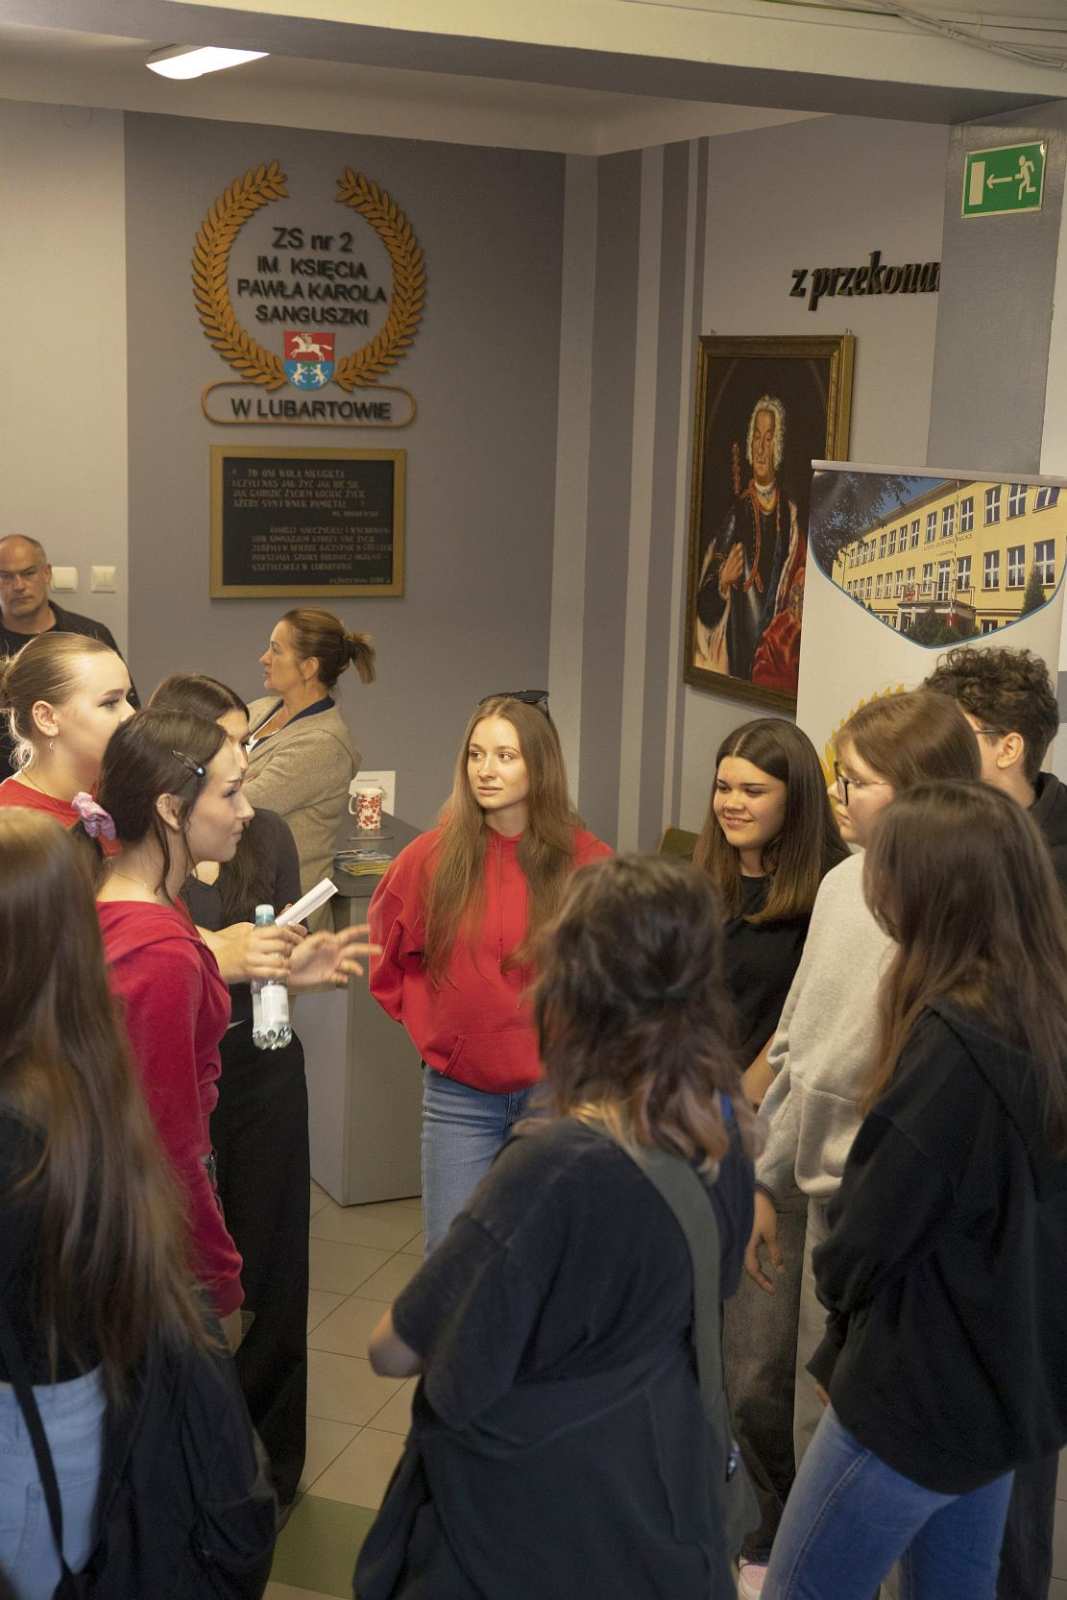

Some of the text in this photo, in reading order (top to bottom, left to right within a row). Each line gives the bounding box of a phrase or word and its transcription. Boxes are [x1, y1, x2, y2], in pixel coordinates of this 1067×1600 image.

[272, 226, 354, 253] ZS nr 2
[290, 257, 369, 282] KSIĘCIA
[789, 250, 941, 312] z przekona
[237, 278, 387, 303] PAWŁA KAROLA
[255, 304, 369, 327] SANGUSZKI
[230, 398, 391, 421] W LUBARTOWIE
